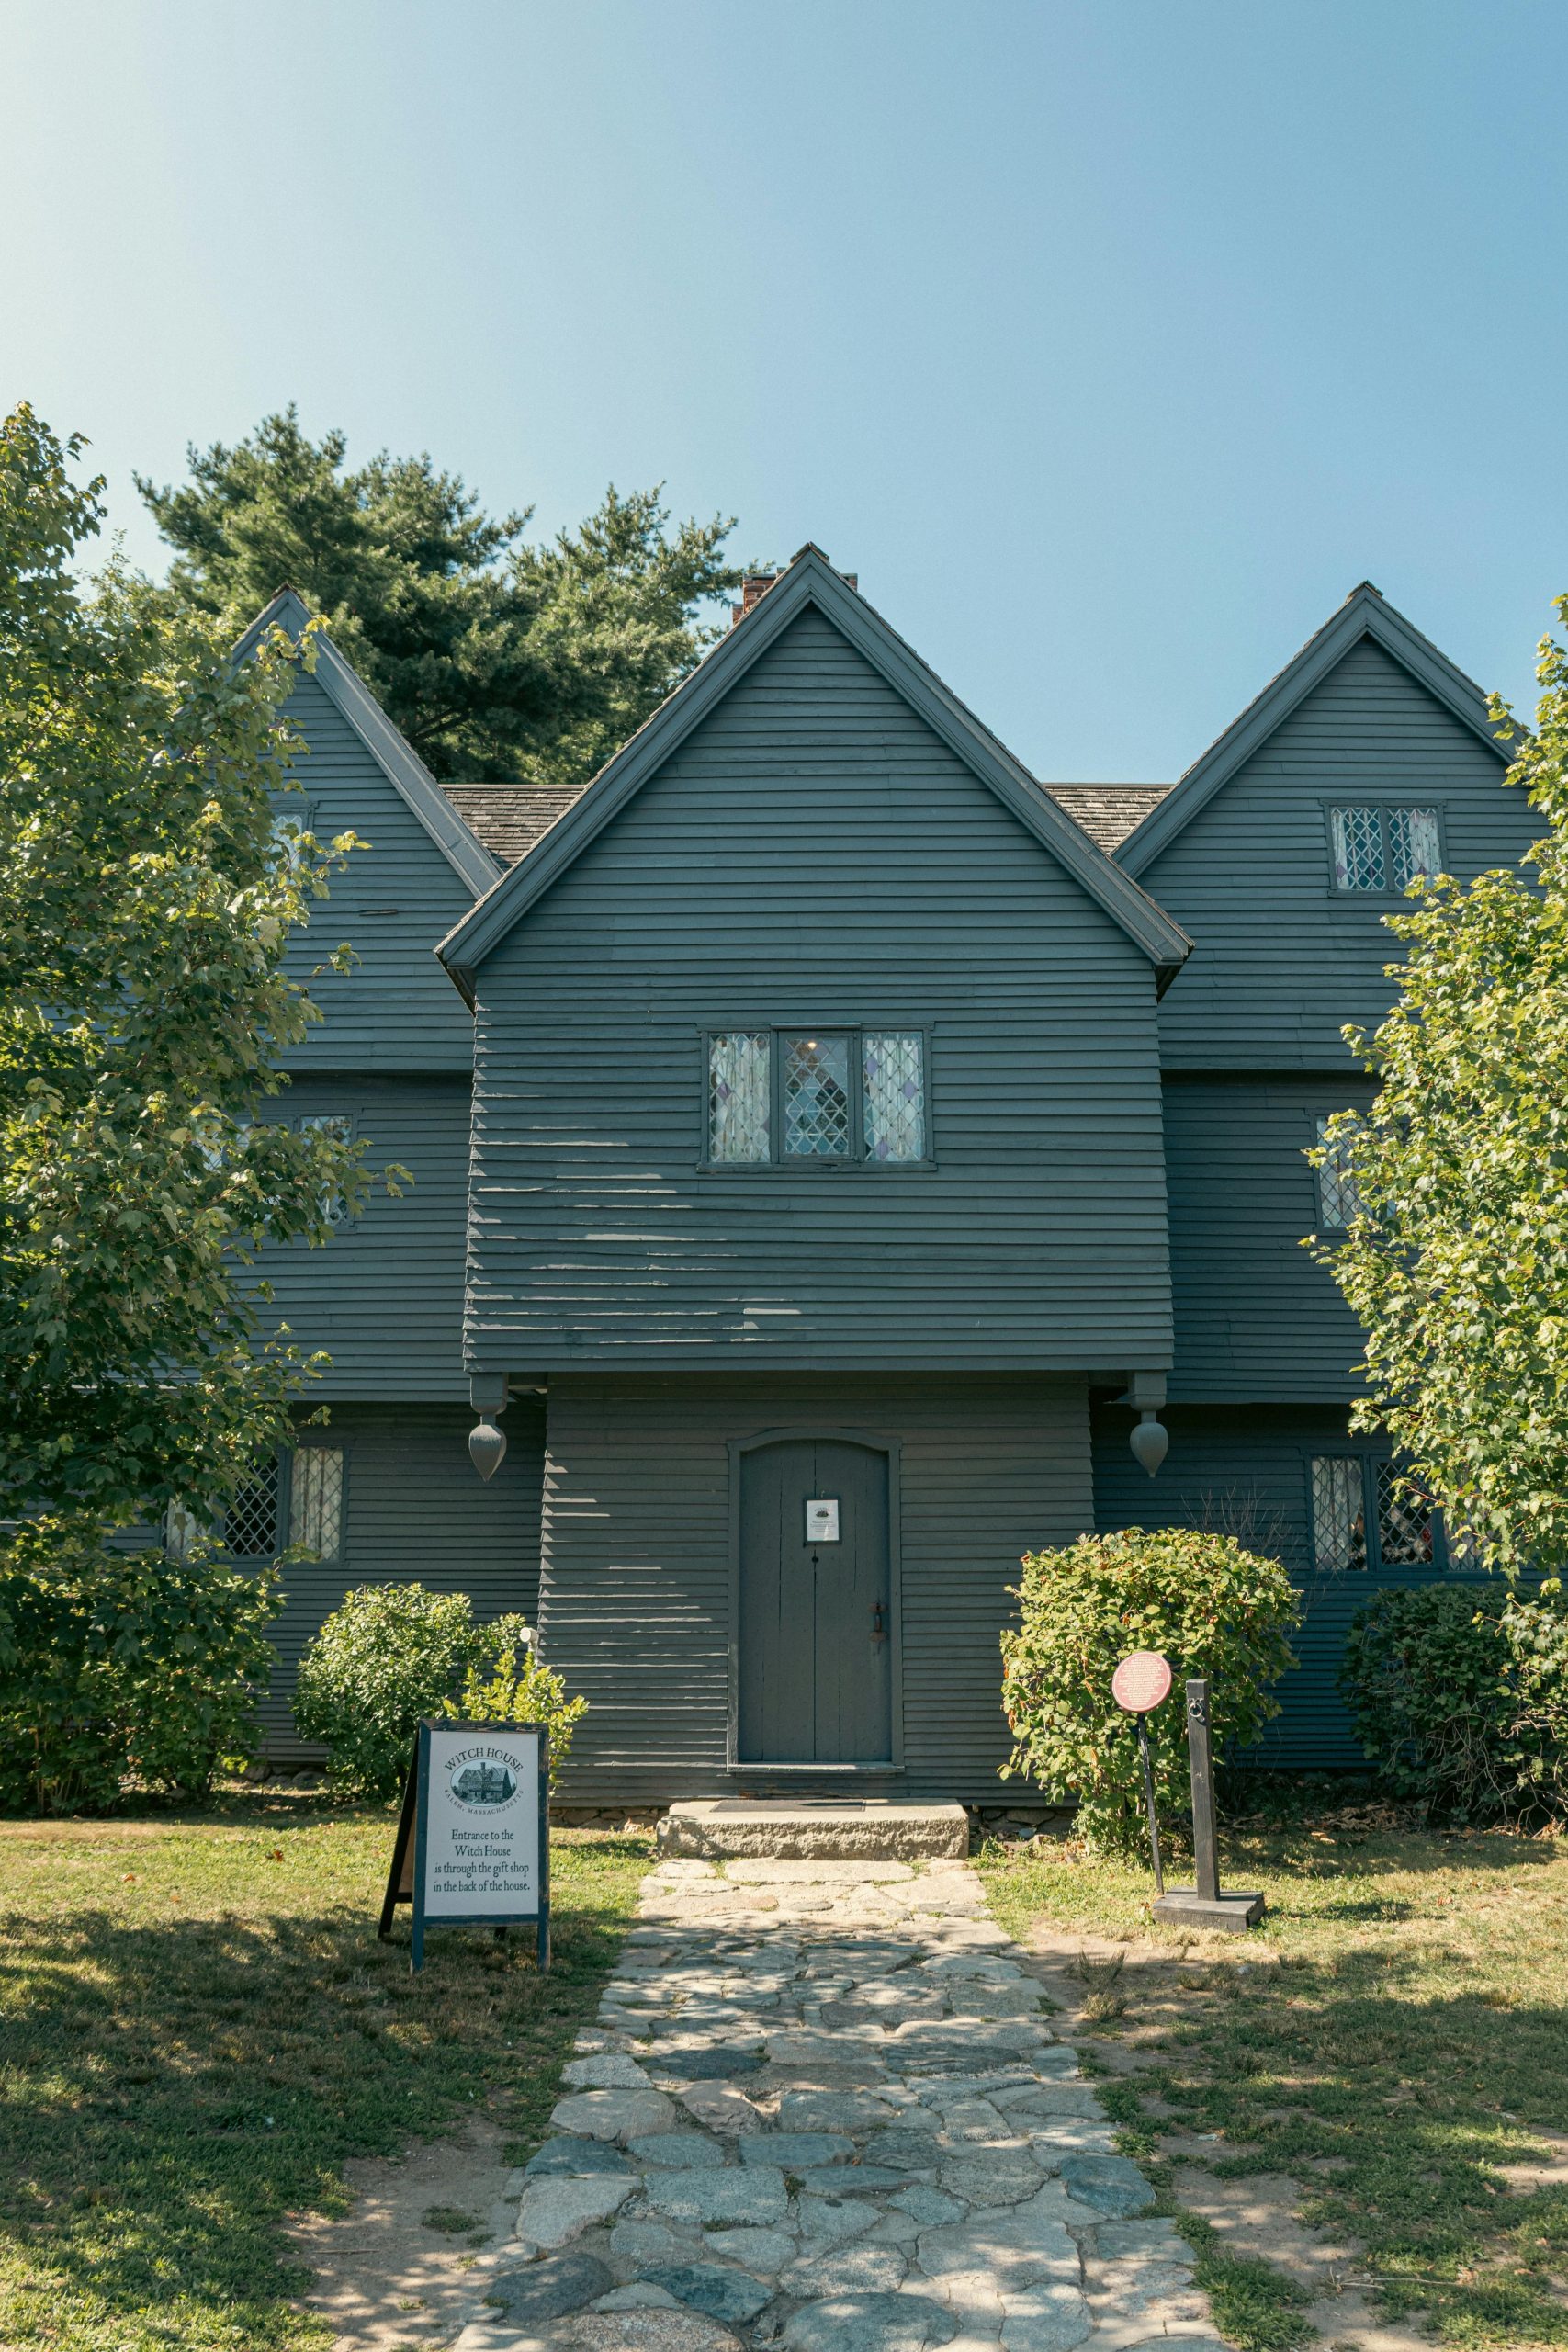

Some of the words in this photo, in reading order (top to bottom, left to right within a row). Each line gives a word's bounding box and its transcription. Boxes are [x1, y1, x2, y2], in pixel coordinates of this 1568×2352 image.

[444, 1747, 484, 1770] WITCH
[487, 1747, 524, 1773] HOUSE
[444, 1789, 465, 1812] SALEM,
[468, 1790, 525, 1815] MASSACHUSETTS
[451, 1828, 489, 1840] Entrance
[491, 1831, 500, 1840] to
[501, 1828, 514, 1840] the
[454, 1845, 483, 1857] Witch
[484, 1845, 512, 1857] House
[434, 1862, 442, 1873] is
[443, 1861, 477, 1878] through
[479, 1861, 491, 1873] the
[492, 1860, 509, 1878] gift
[510, 1861, 530, 1877] shop
[434, 1880, 442, 1892] in
[443, 1880, 457, 1892] the
[458, 1880, 478, 1892] back
[478, 1880, 489, 1892] of
[490, 1880, 502, 1891] the
[503, 1880, 531, 1891] house.
